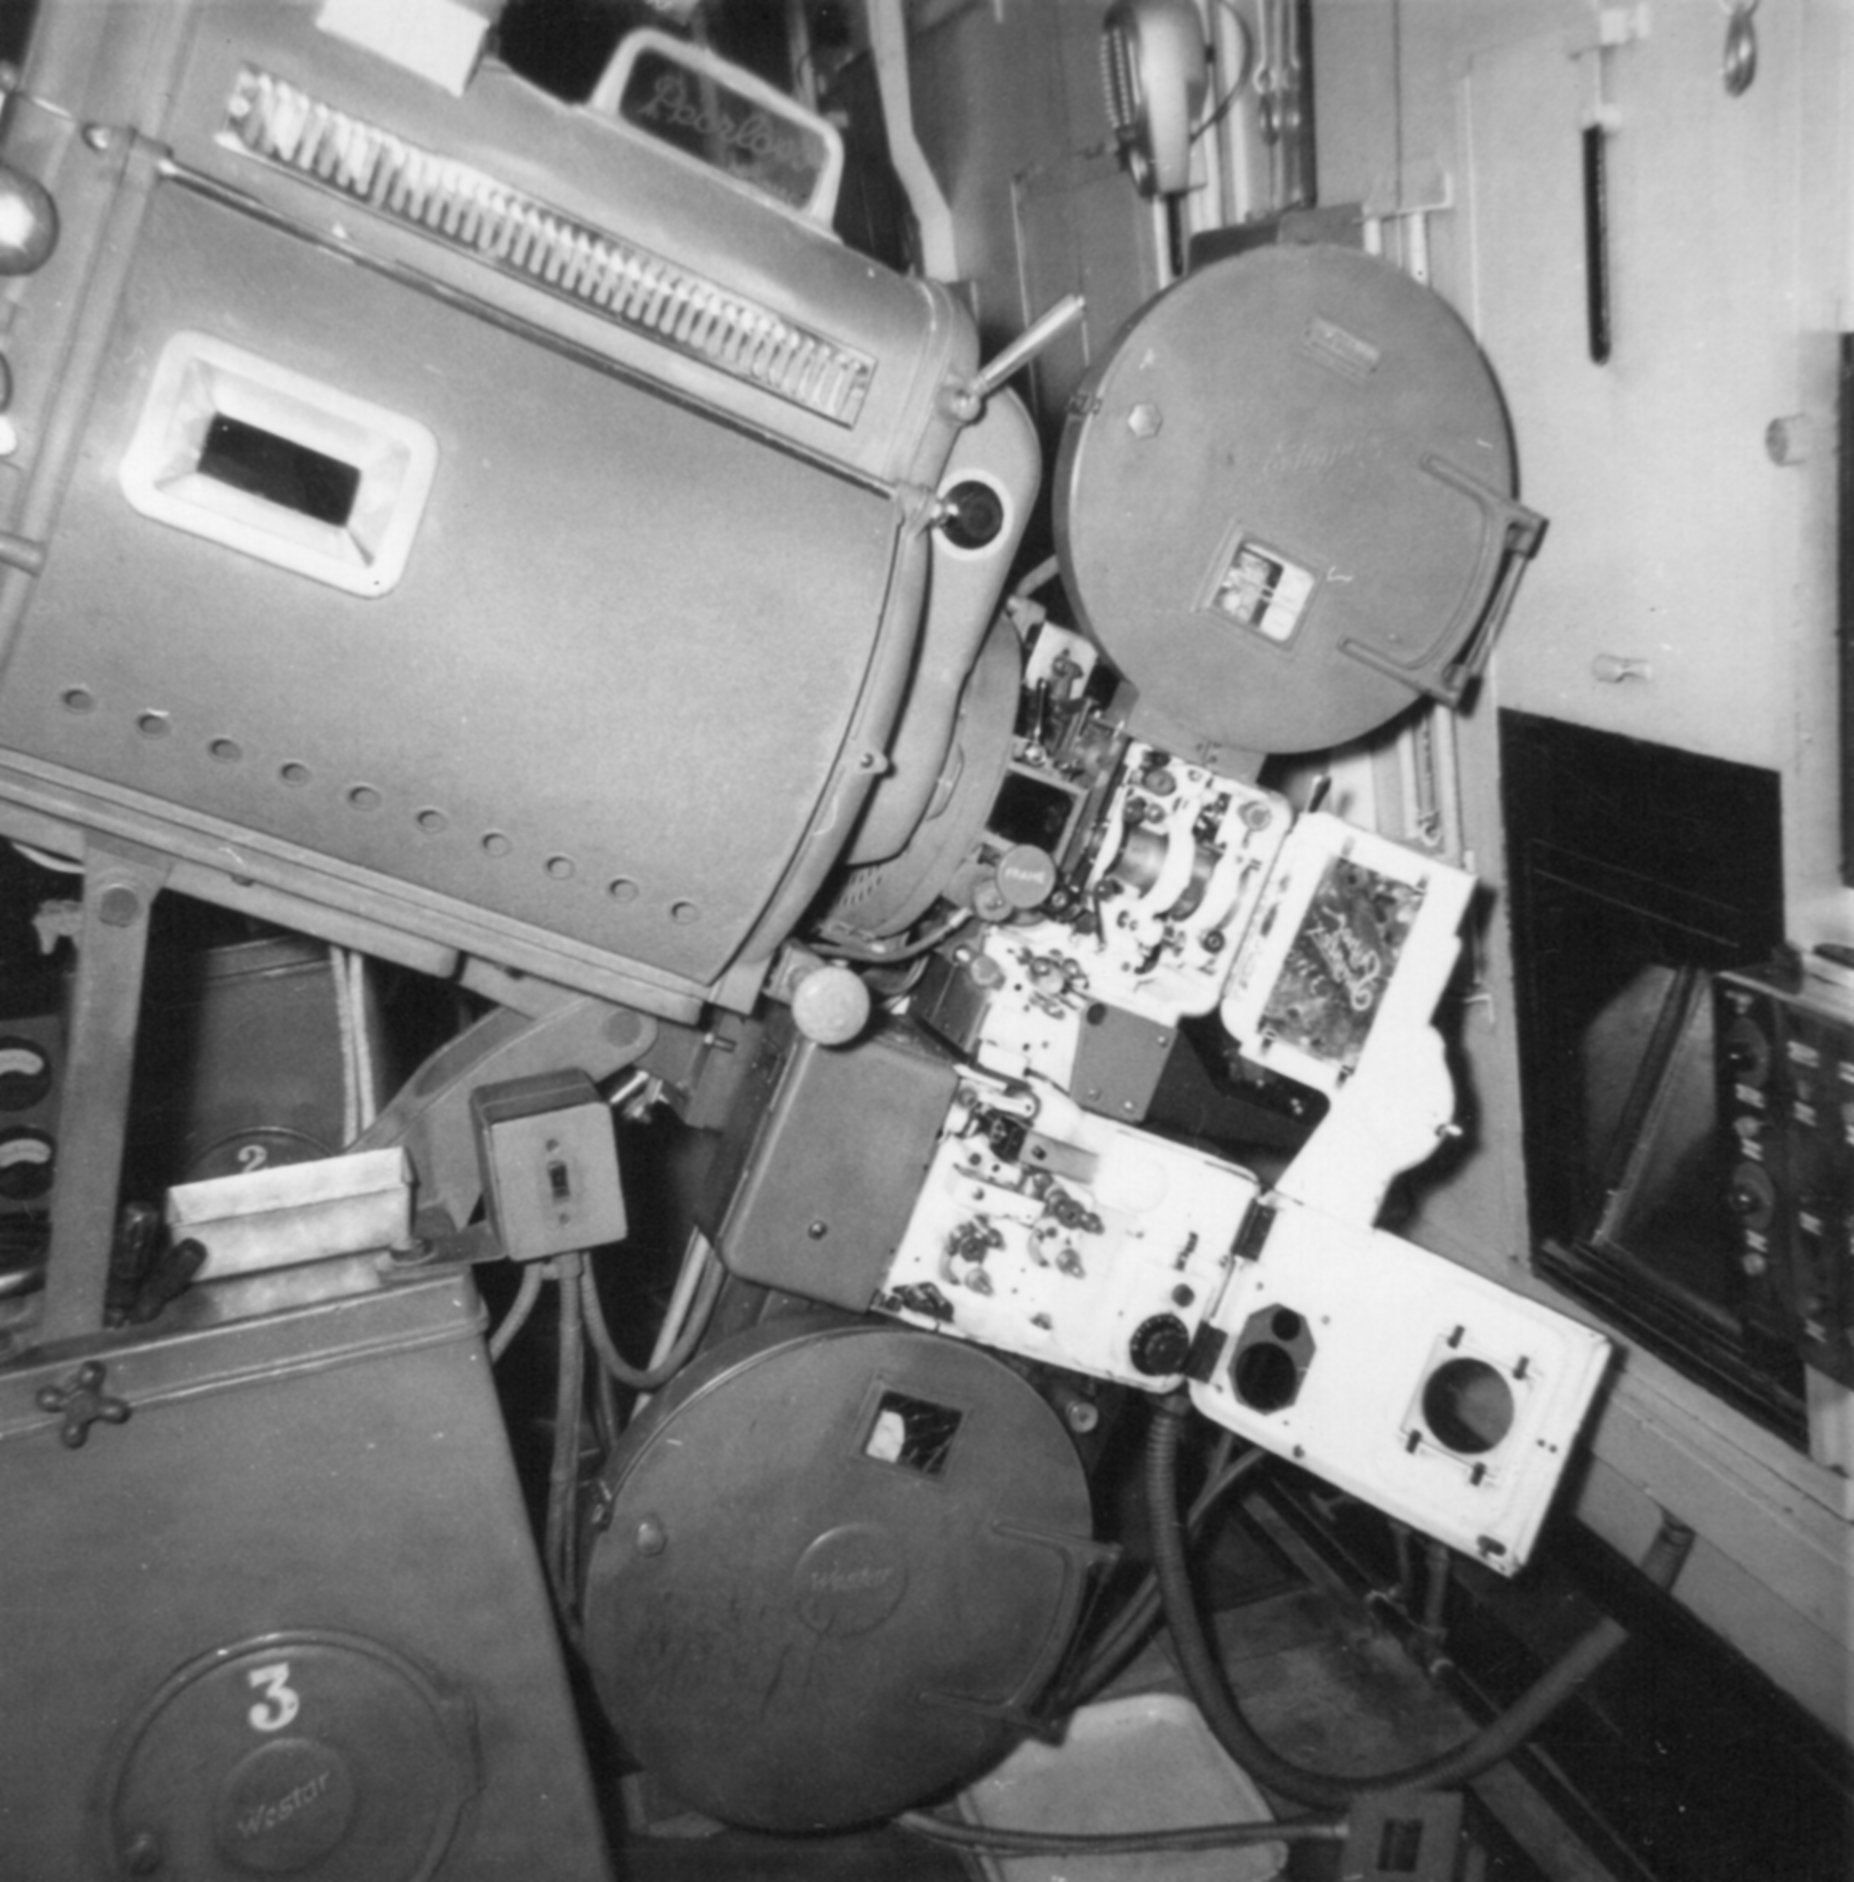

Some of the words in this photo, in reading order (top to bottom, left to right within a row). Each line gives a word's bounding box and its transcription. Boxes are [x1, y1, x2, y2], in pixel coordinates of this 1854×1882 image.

[238, 1144, 267, 1173] 2
[248, 1662, 299, 1732] 3
[237, 1770, 330, 1839] Westar
